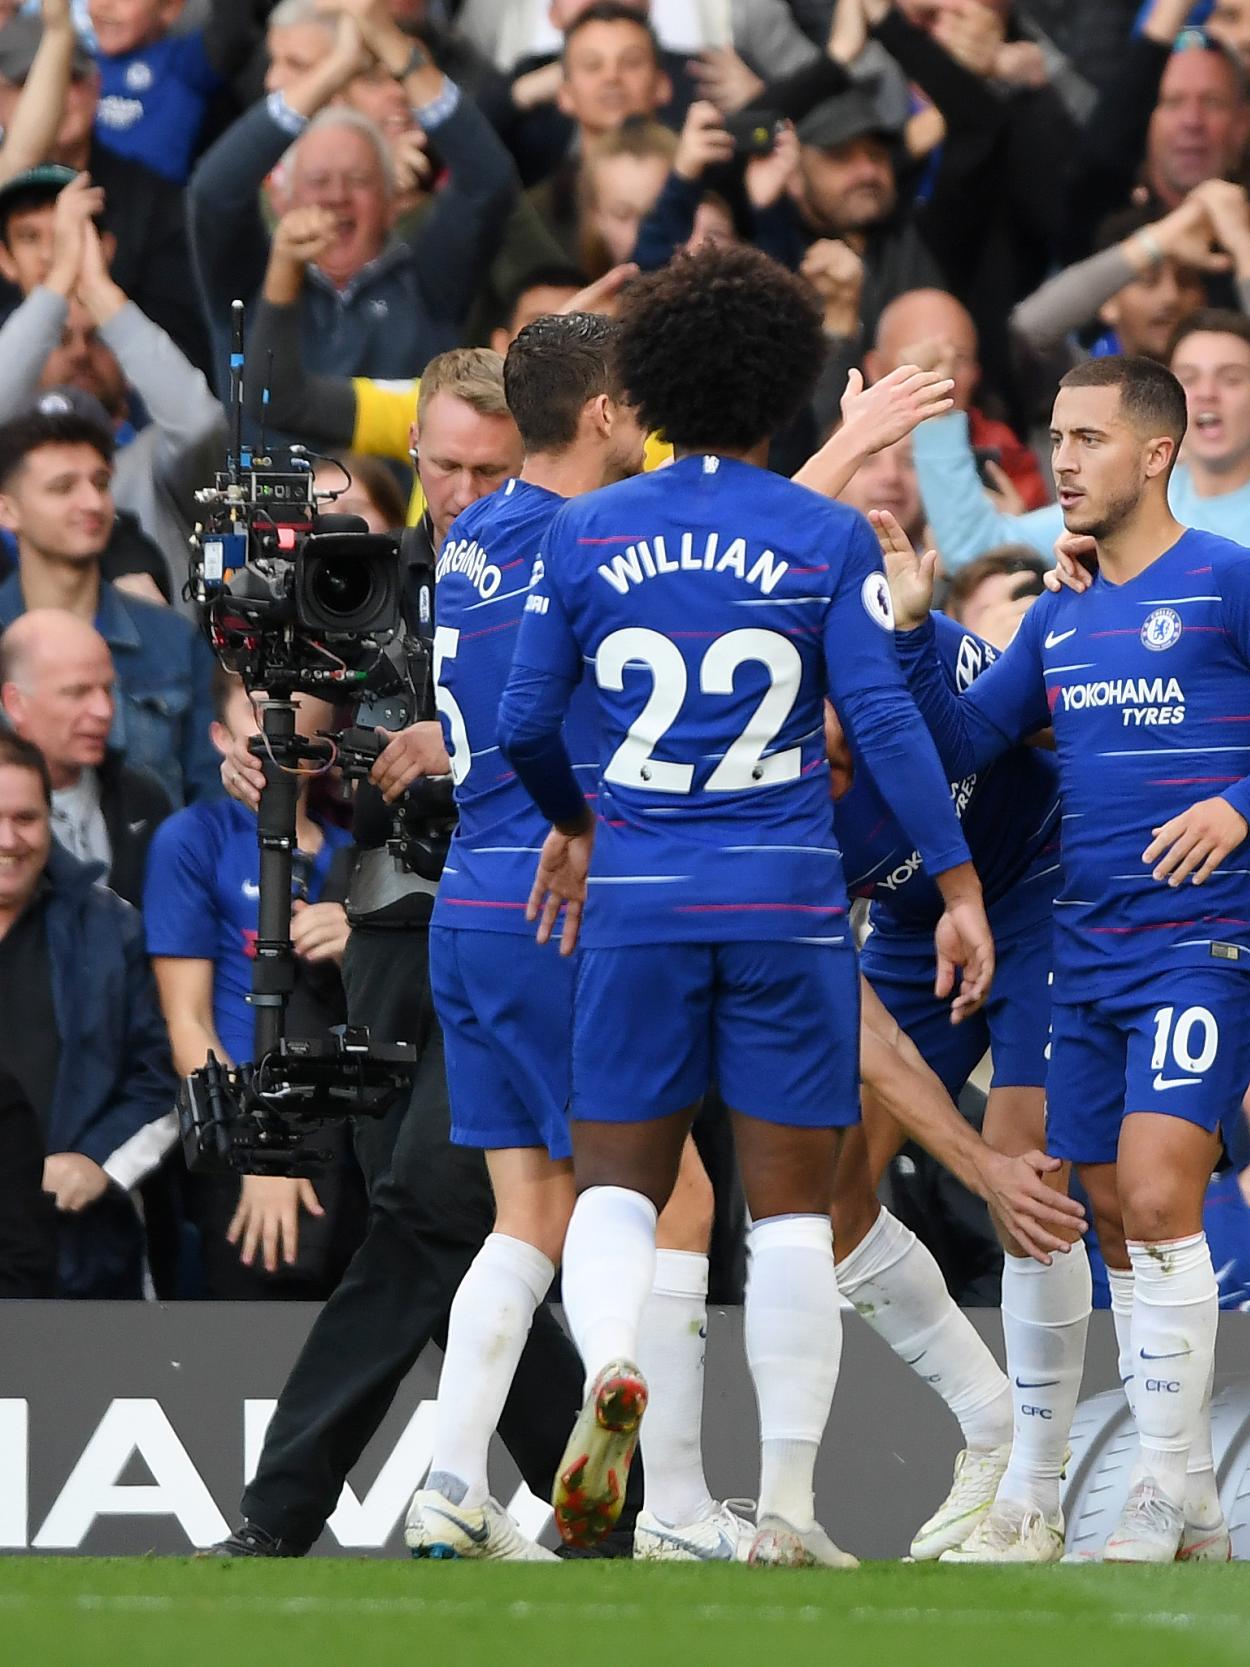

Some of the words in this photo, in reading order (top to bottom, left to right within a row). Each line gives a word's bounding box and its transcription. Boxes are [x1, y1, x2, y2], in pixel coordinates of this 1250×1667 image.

[598, 532, 789, 595] WILLIAN
[433, 625, 472, 786] 5
[595, 626, 803, 795] 22
[1061, 677, 1185, 711] YOKOHAMA
[1122, 705, 1186, 726] TYRES
[876, 850, 924, 891] YOK
[1151, 1006, 1219, 1074] 10
[1145, 1378, 1180, 1393] CFC
[1021, 1404, 1053, 1420] CFC
